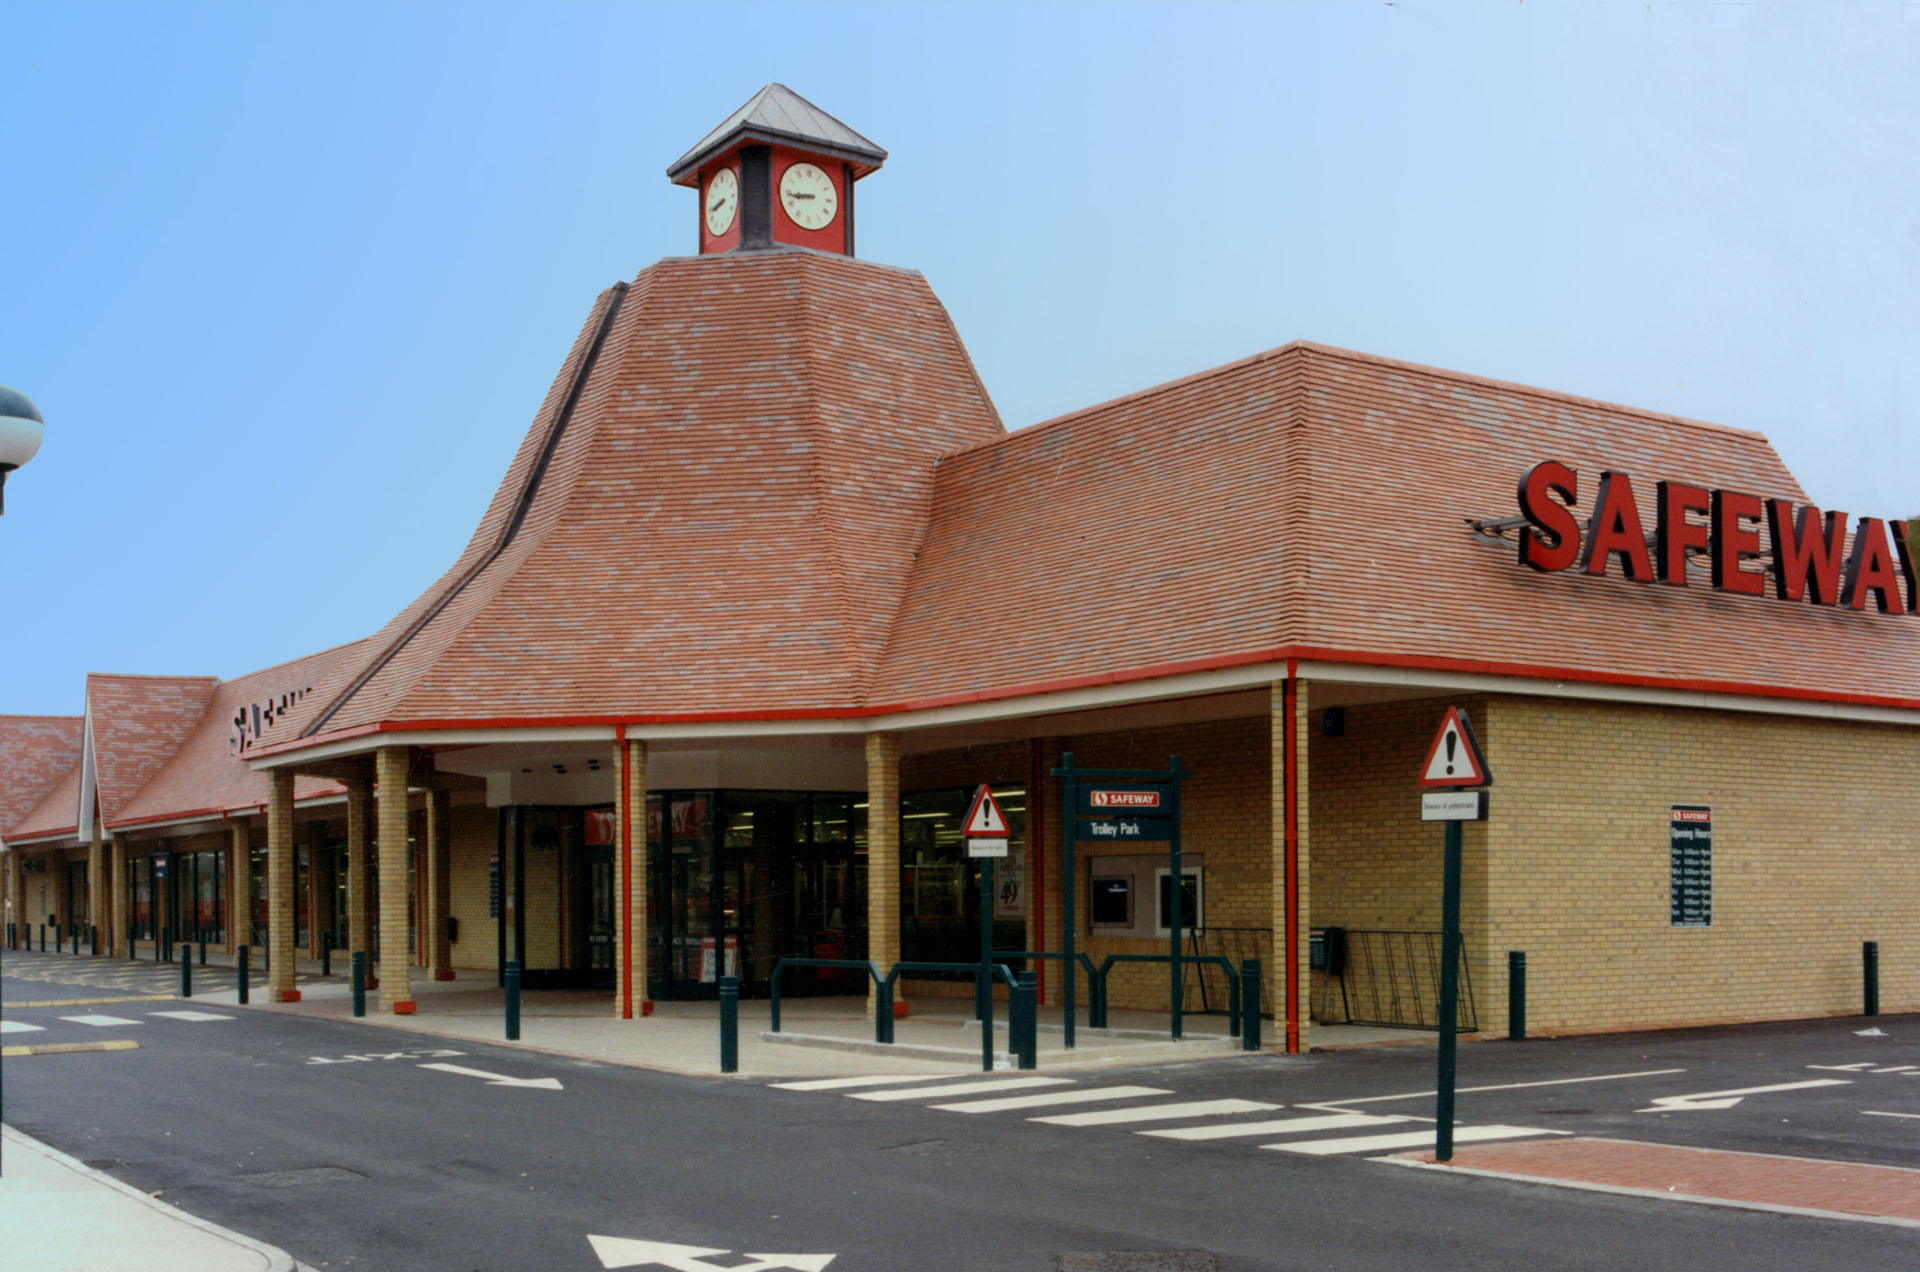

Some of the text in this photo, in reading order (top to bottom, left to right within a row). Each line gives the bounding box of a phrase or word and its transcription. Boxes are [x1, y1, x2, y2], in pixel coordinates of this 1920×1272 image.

[1110, 794, 1154, 804] SAFEWAY
[1090, 822, 1140, 838] Trolley Park
